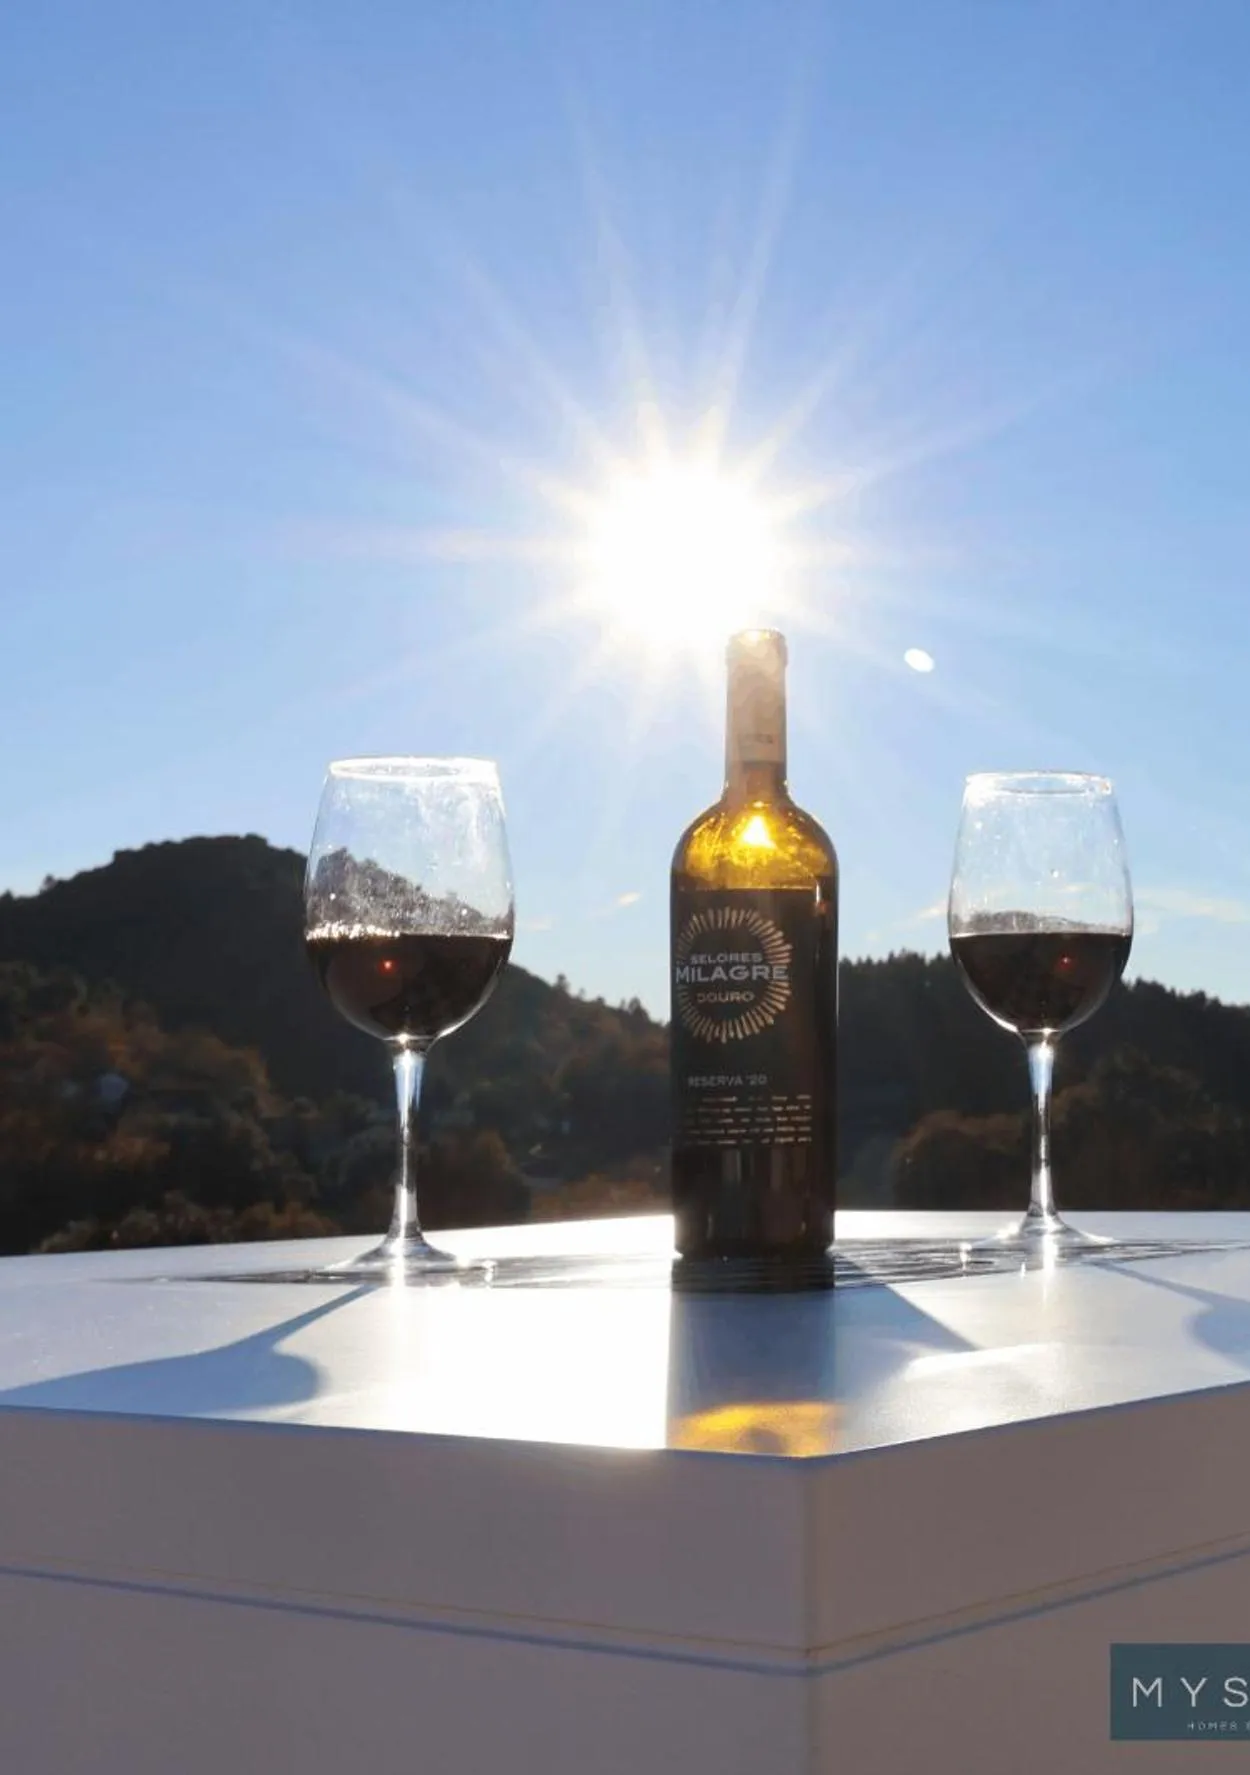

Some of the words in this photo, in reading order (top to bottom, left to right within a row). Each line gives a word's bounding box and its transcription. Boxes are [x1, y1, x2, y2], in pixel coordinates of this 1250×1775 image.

[690, 952, 763, 965] SELORES
[675, 964, 789, 985] MILAGRE
[696, 991, 755, 1004] DOURO
[687, 1074, 744, 1088] RESERVA
